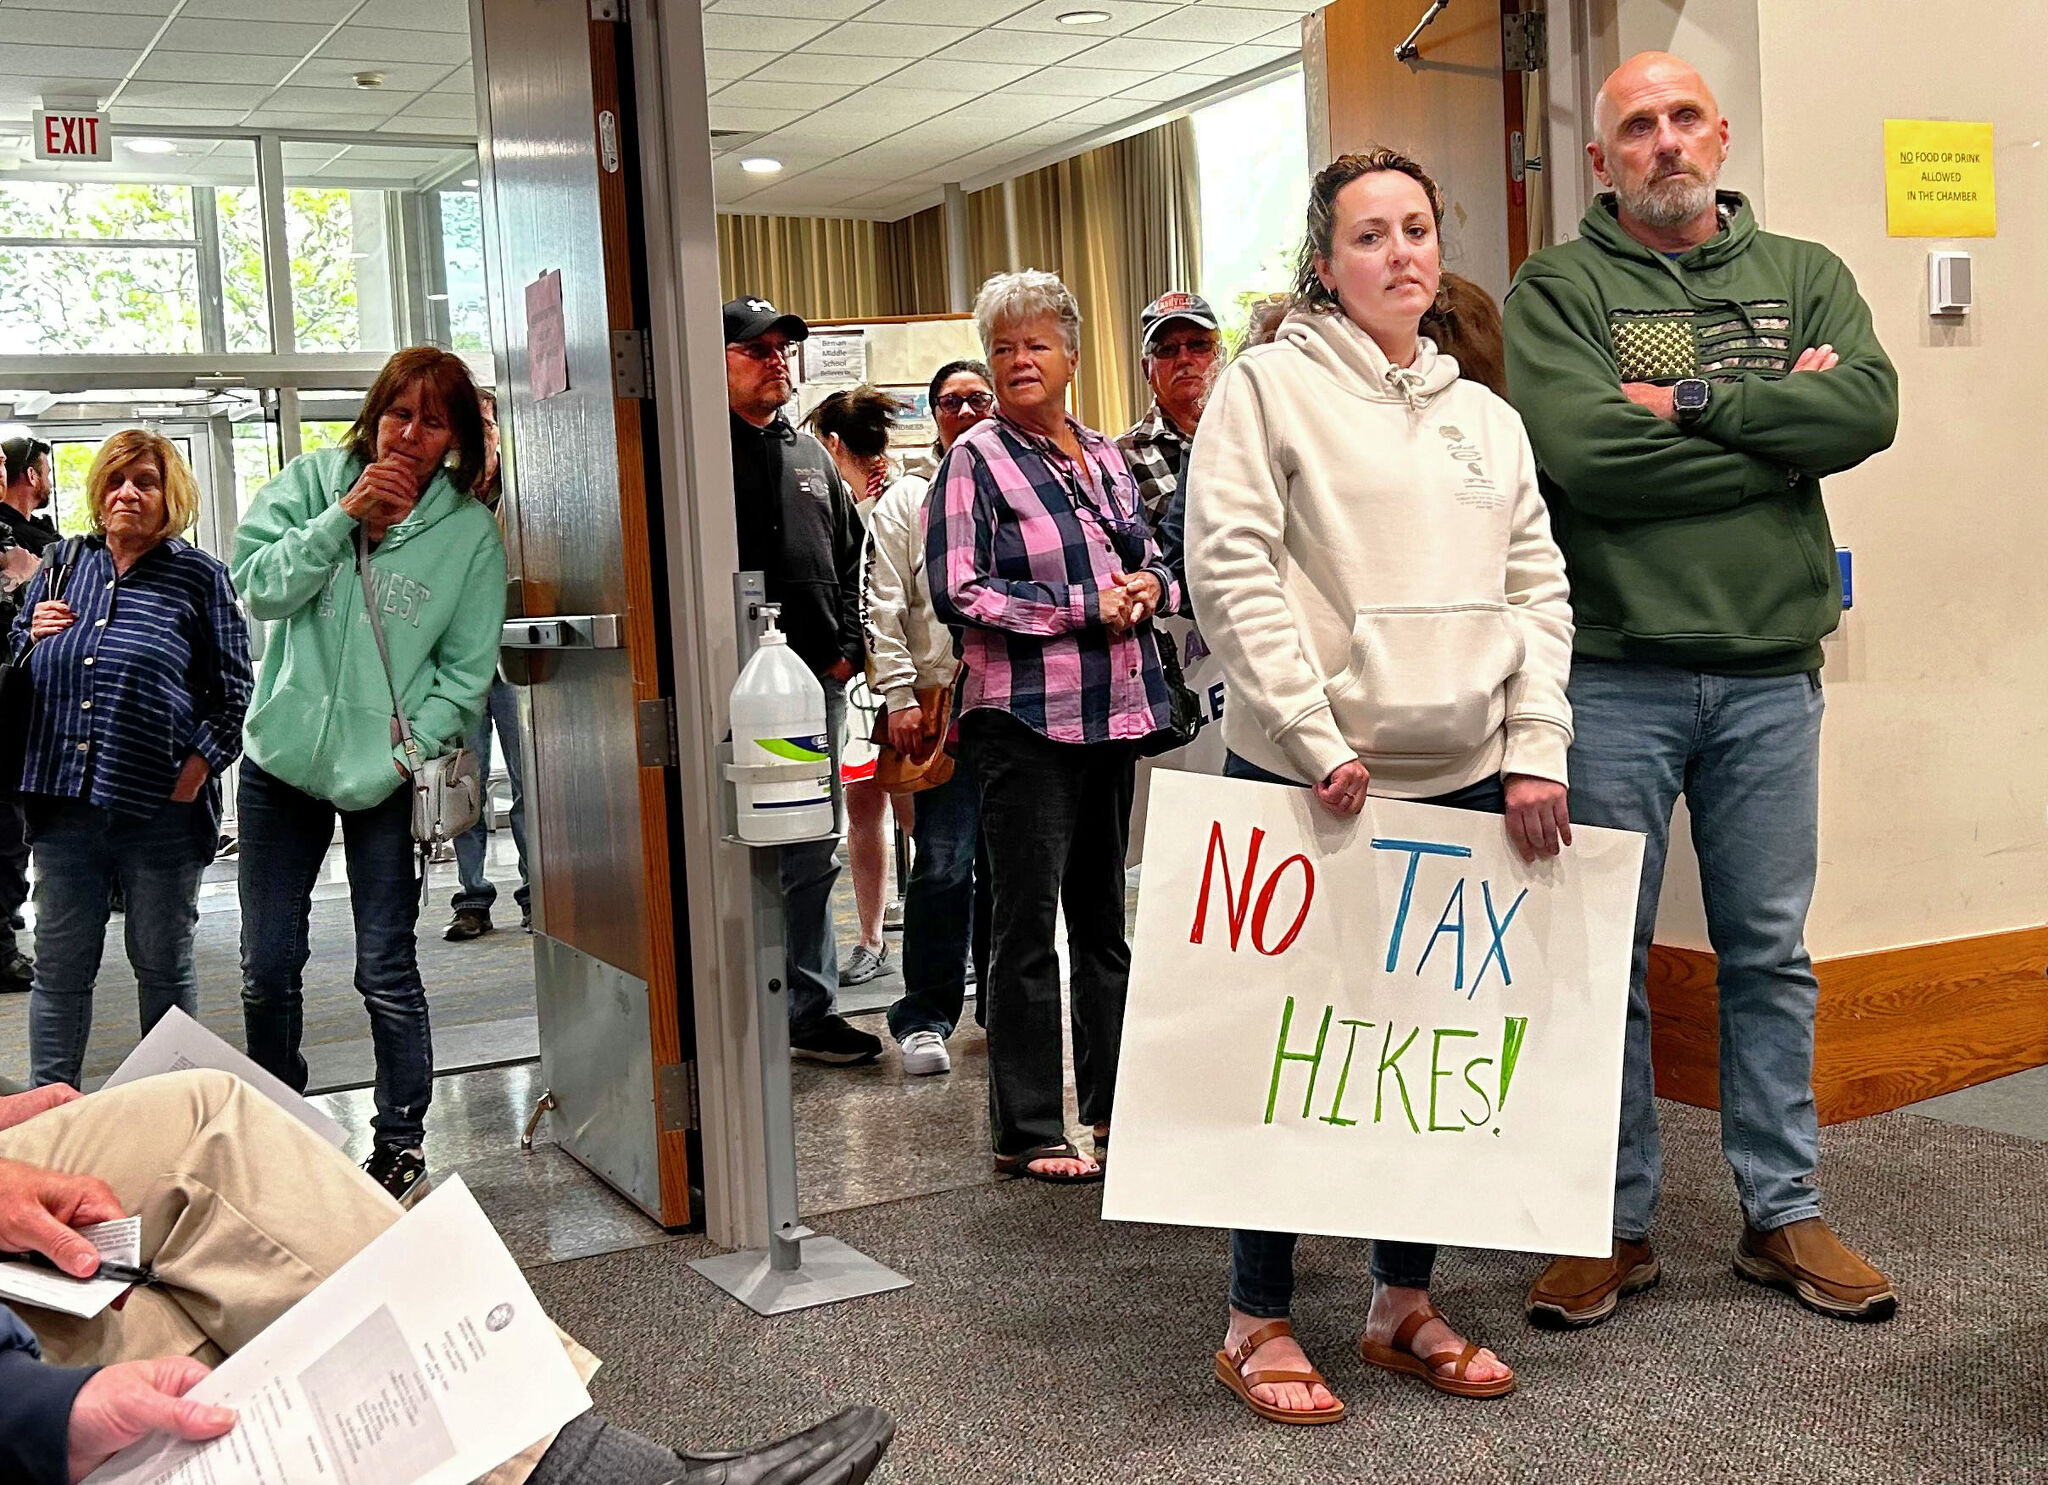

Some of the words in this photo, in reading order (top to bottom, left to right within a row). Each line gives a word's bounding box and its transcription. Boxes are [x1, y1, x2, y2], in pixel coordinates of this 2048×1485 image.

[45, 116, 99, 155] EXIT
[1900, 152, 1914, 164] NO
[1915, 152, 1940, 162] FOOD
[1941, 152, 1953, 162] OR
[1955, 153, 1980, 163] DRINK
[1921, 171, 1962, 182] ALLOWED
[1907, 191, 1916, 201] IN
[1918, 191, 1935, 201] THE
[1936, 191, 1978, 202] CHAMBER
[370, 566, 431, 628] WEST
[1190, 820, 1315, 956] NO
[1370, 838, 1529, 1000] TAX
